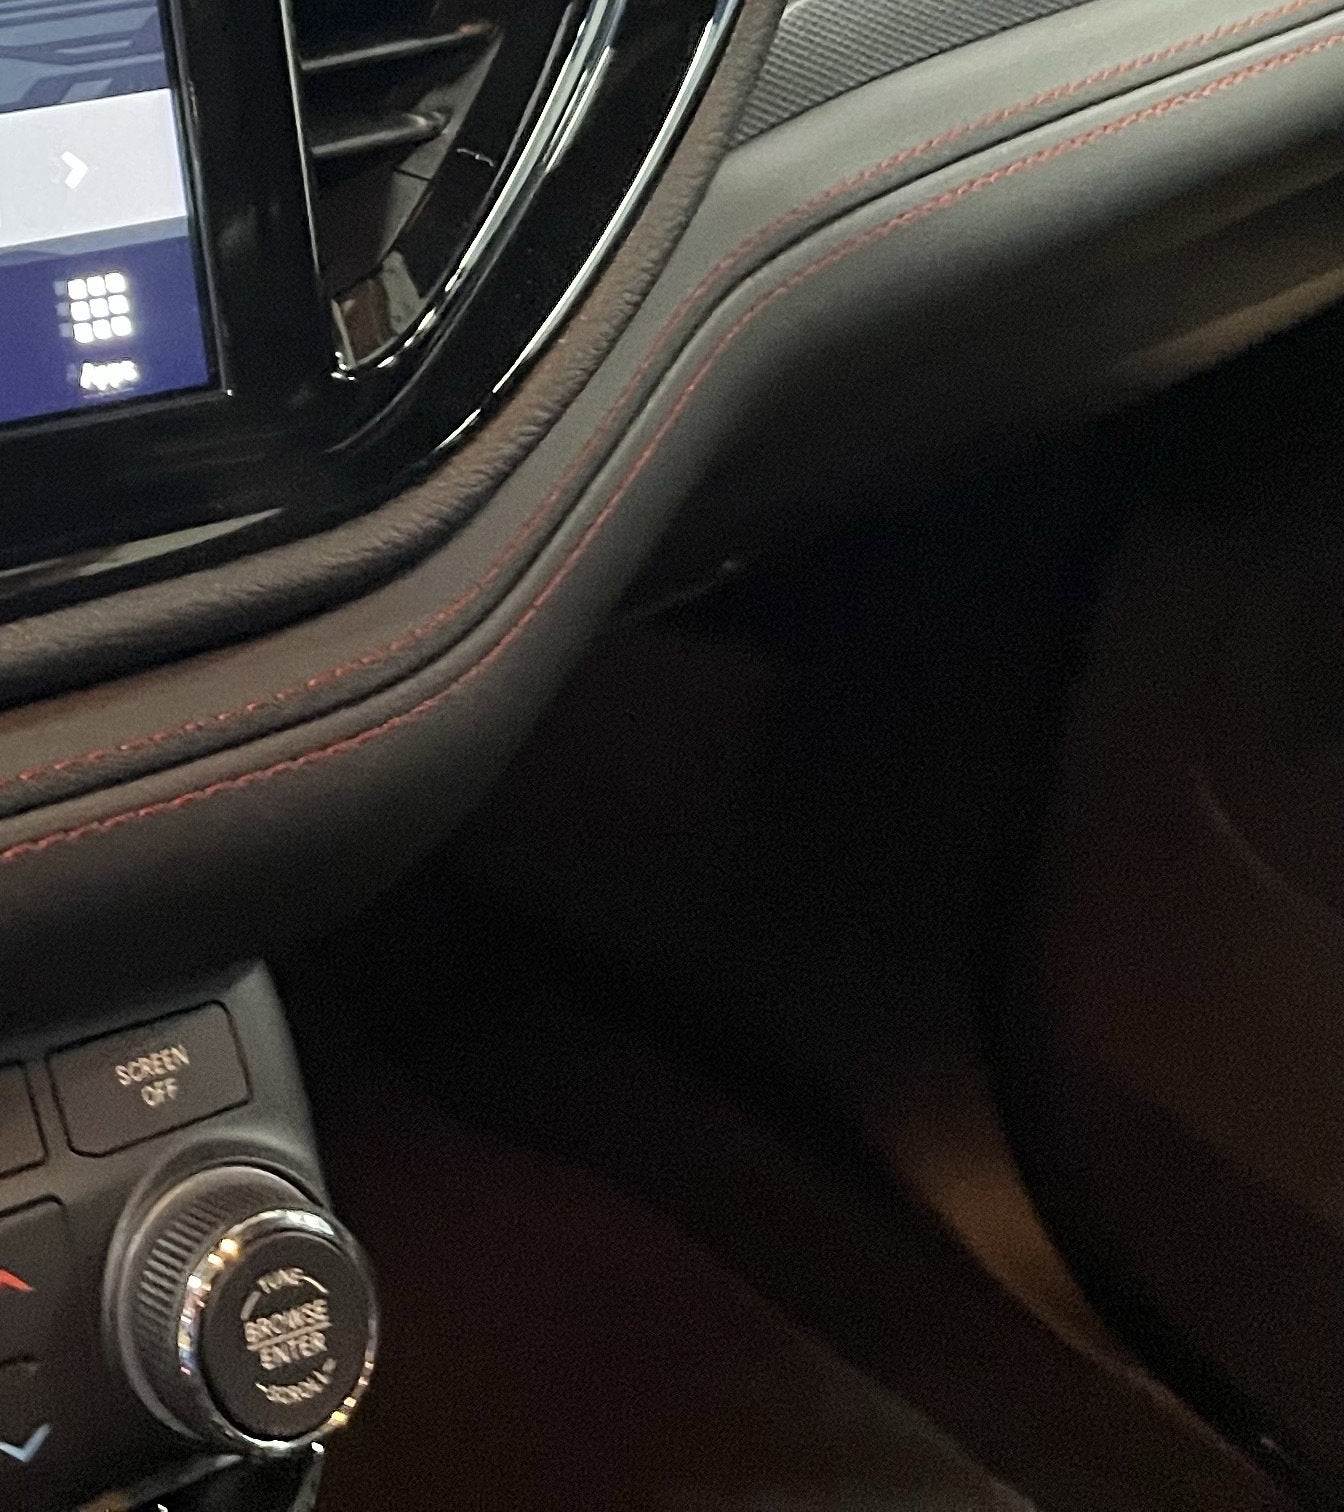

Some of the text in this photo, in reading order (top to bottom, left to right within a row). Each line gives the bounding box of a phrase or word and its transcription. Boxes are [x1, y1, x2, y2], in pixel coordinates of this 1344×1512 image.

[79, 359, 139, 389] Apps
[114, 1044, 190, 1086] SCREEN
[140, 1077, 179, 1106] OFF
[244, 1298, 331, 1344] BROWSE
[259, 1331, 328, 1371] ENTER
